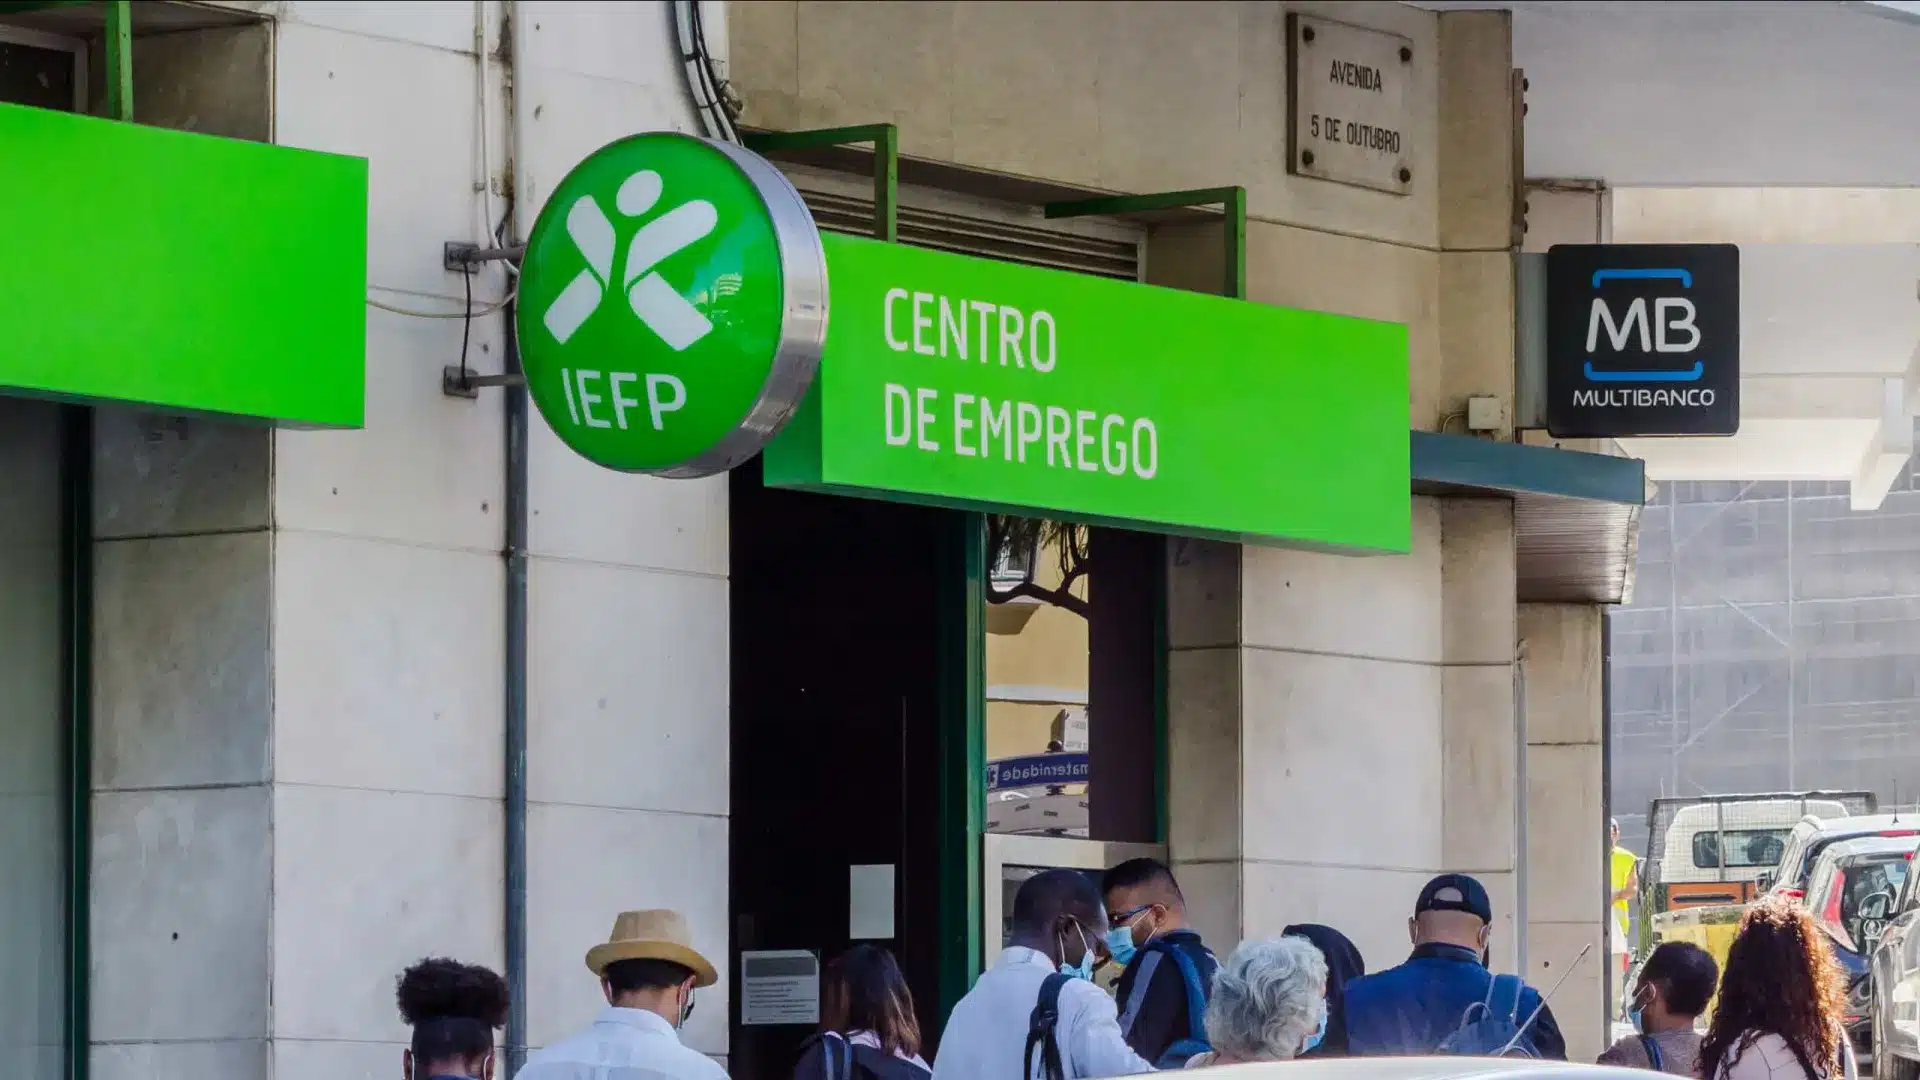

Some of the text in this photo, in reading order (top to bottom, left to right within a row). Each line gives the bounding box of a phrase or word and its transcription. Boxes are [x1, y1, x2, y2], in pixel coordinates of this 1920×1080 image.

[1329, 59, 1383, 92] AVENIDA
[1310, 114, 1400, 153] 5 DE OUTUBRO
[884, 287, 1056, 372] CENTRO
[1585, 297, 1701, 353] MB
[561, 367, 687, 430] IEFP
[1573, 388, 1715, 406] MULTIBANCO
[885, 383, 1158, 479] DE EMPREGO
